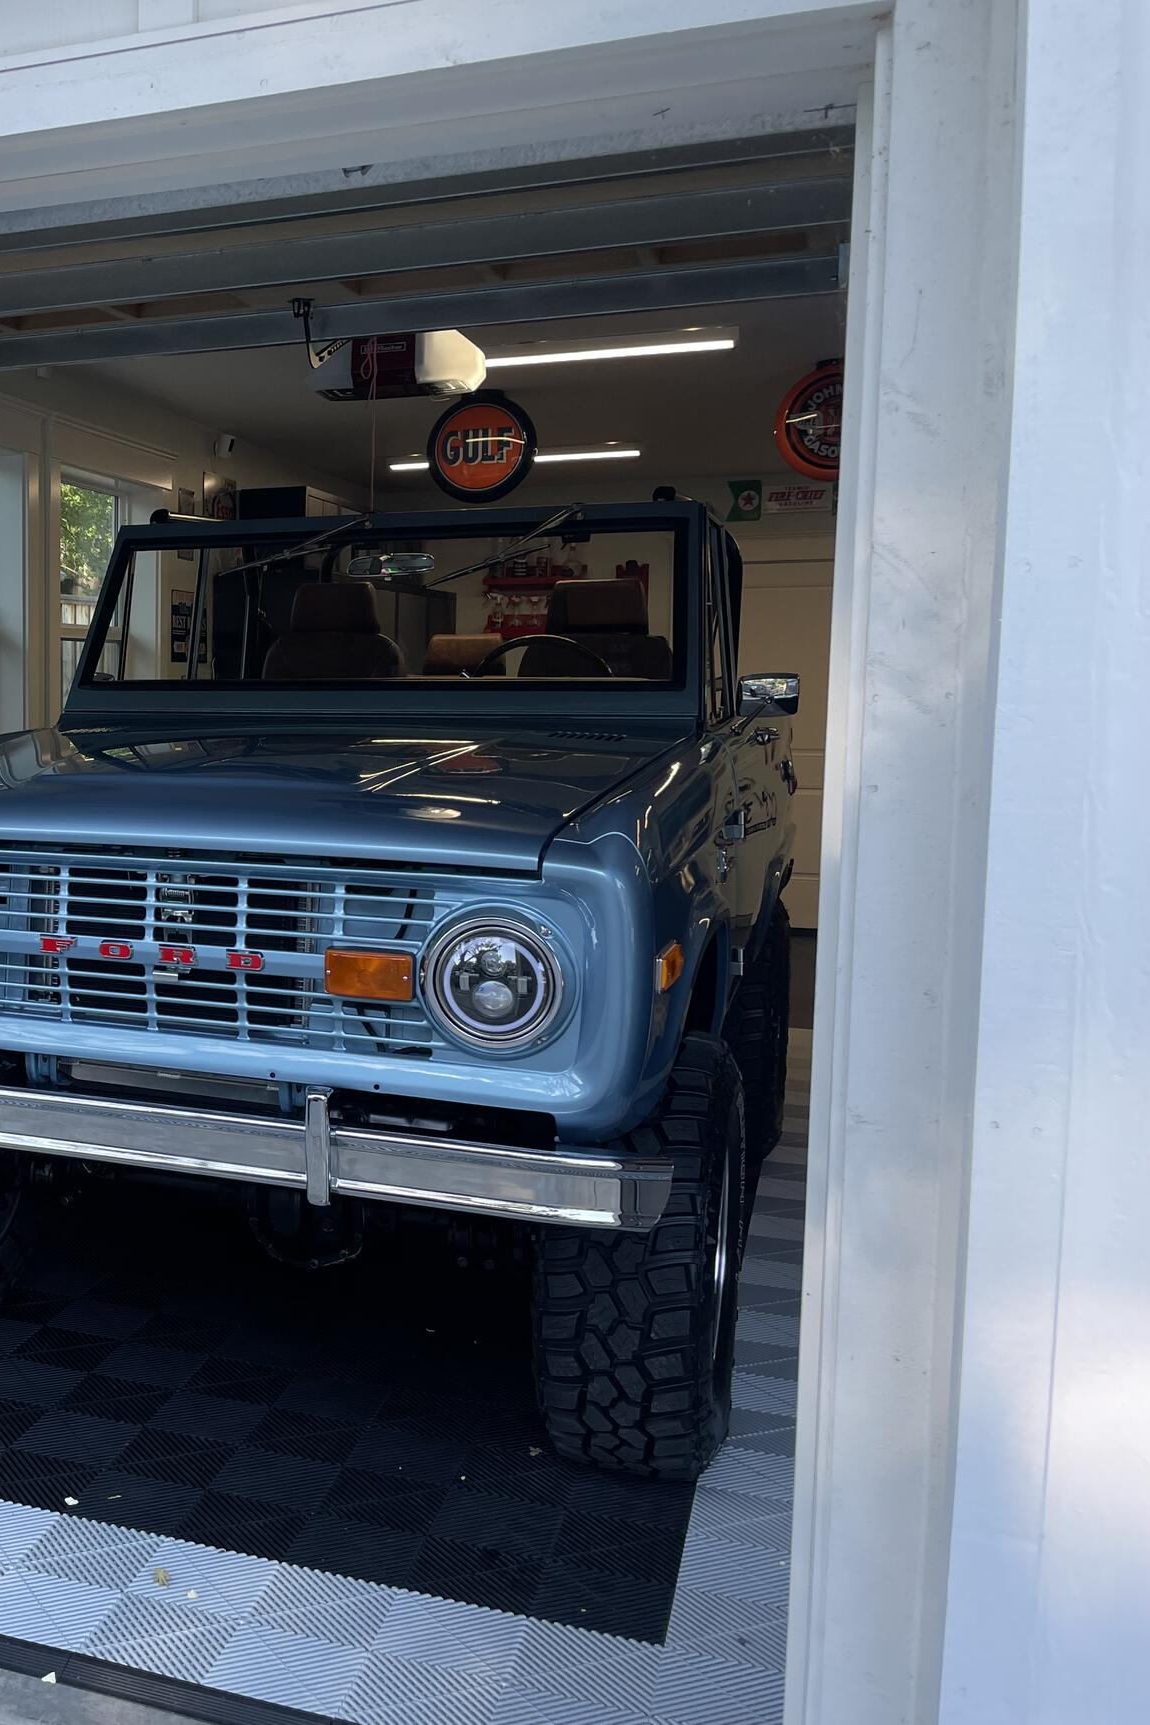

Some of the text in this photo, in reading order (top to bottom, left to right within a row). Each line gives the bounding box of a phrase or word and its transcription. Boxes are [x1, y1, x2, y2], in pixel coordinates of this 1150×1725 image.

[807, 384, 844, 412] JOHN
[442, 426, 515, 466] GULF
[40, 934, 266, 972] FORD
